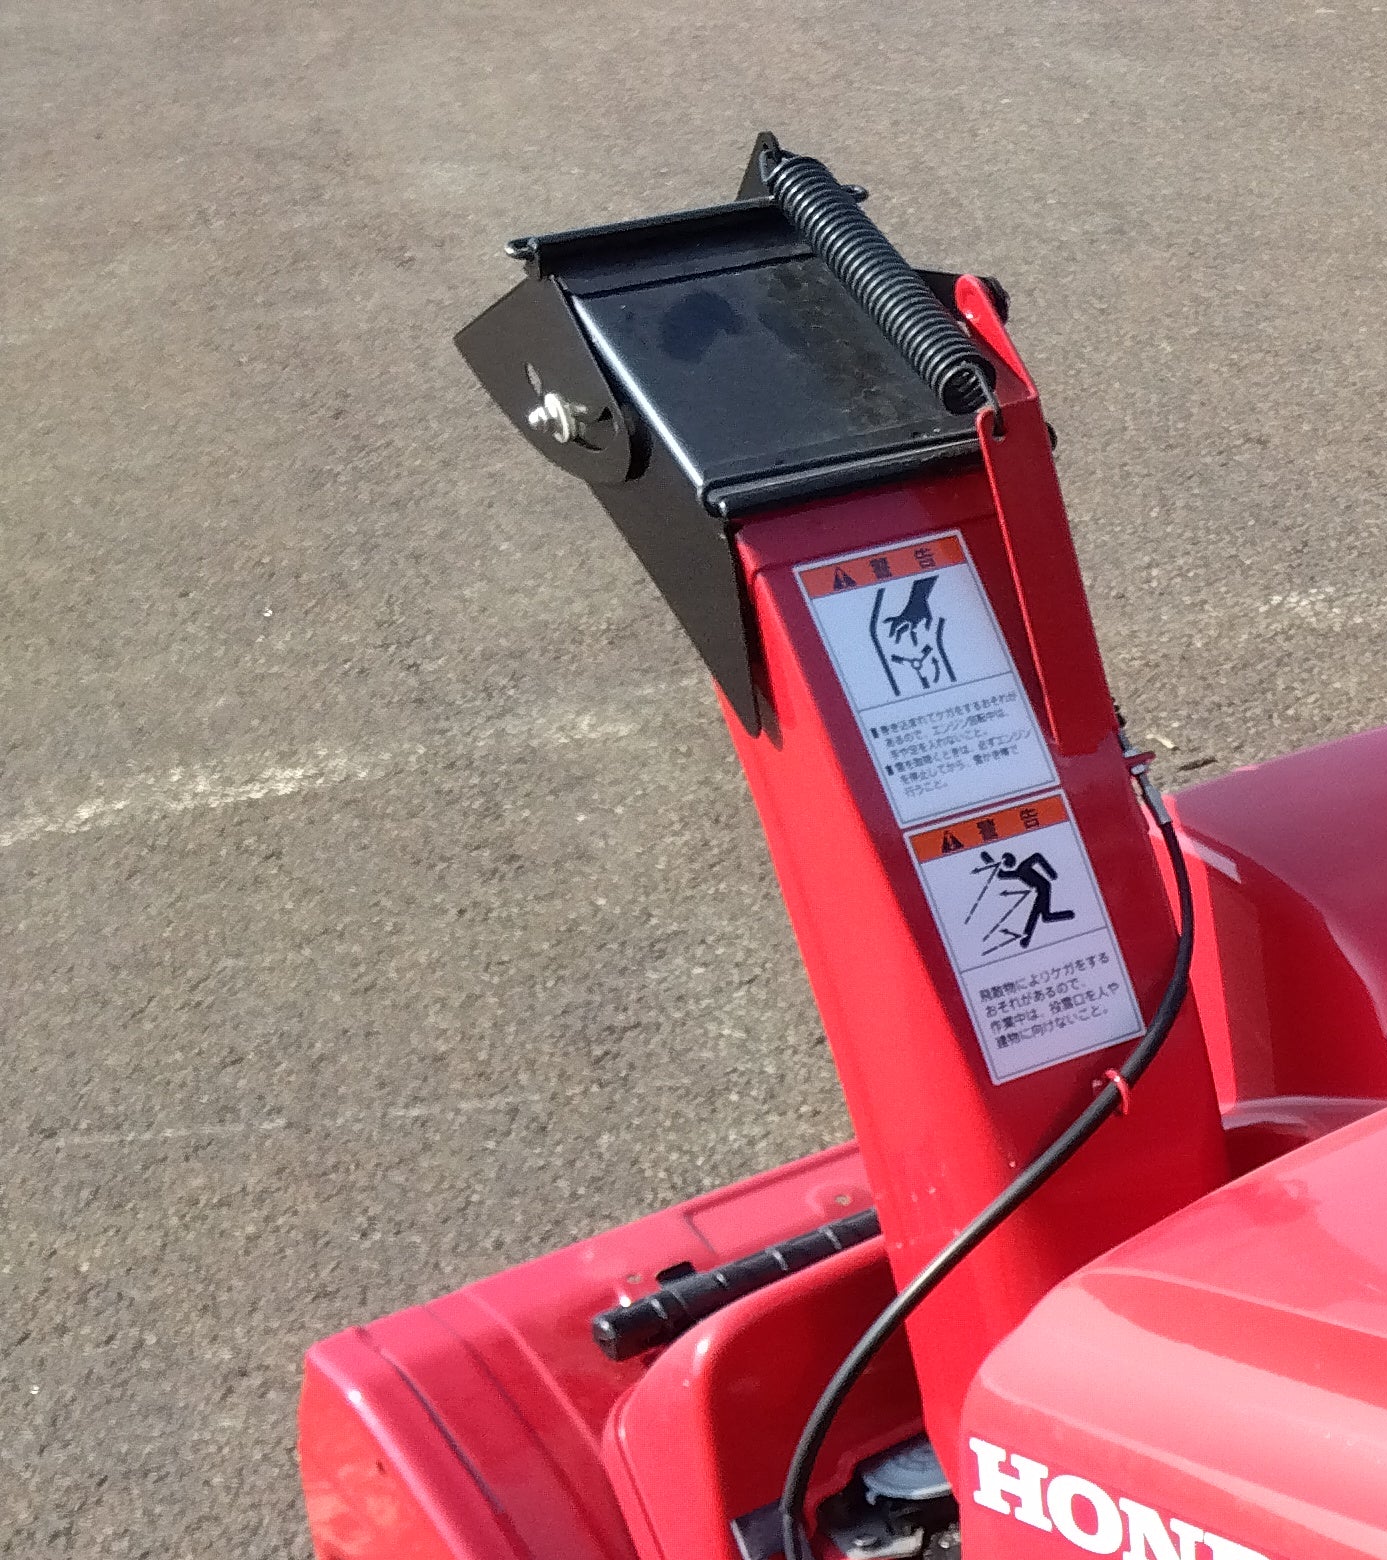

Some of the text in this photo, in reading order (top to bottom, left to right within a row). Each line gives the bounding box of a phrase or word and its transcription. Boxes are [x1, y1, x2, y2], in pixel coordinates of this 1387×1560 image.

[976, 950, 1111, 1002] 飛散物によりケガをする
[982, 975, 1087, 1019] おそれがあるので、
[994, 1001, 1109, 1050] 建物に向けないこと。
